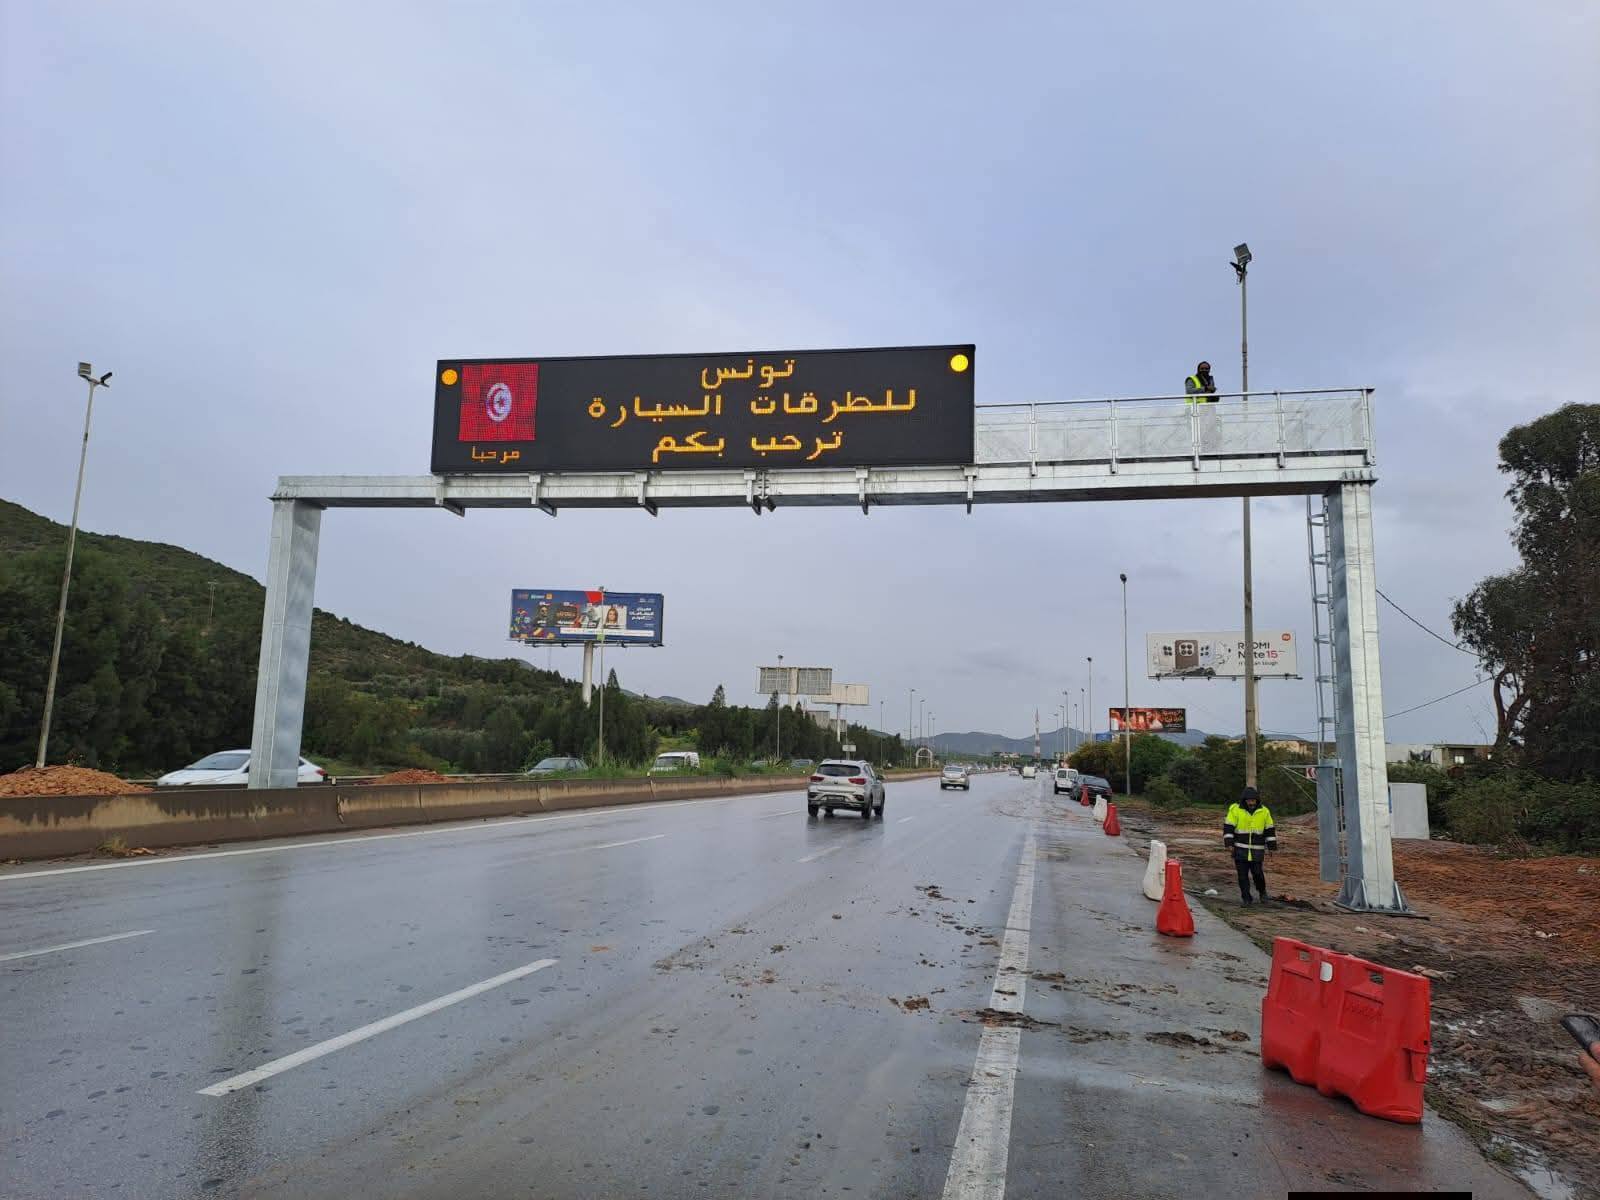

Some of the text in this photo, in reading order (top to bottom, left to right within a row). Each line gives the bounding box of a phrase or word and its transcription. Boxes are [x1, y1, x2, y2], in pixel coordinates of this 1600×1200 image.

[701, 359, 795, 389] تونس
[588, 389, 916, 427] للطرقات السيارة
[472, 446, 520, 464] مرحبا
[652, 431, 843, 463] ترحب بكم
